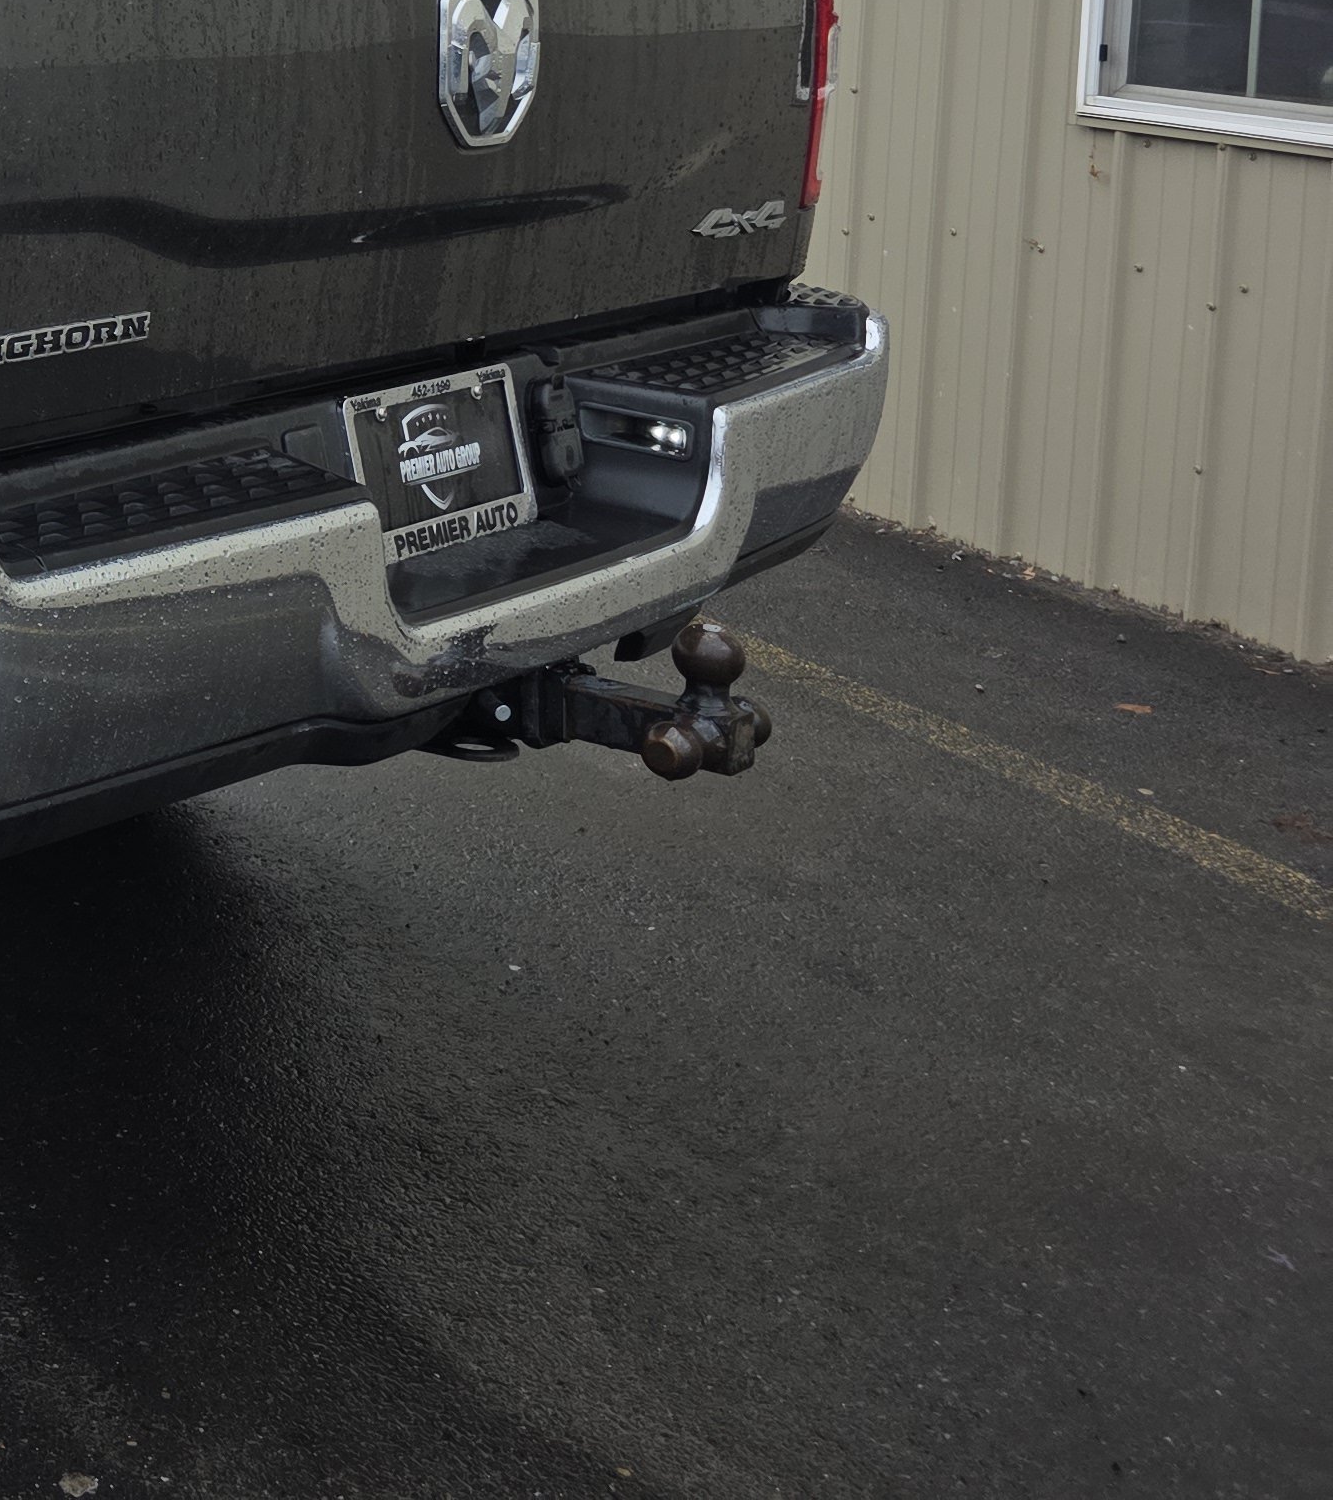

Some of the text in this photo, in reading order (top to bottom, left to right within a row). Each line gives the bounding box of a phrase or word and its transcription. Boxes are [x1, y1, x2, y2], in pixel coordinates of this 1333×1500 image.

[399, 442, 481, 484] PREMIER AUTO GROUP
[393, 501, 519, 558] PREMIER AUTO
